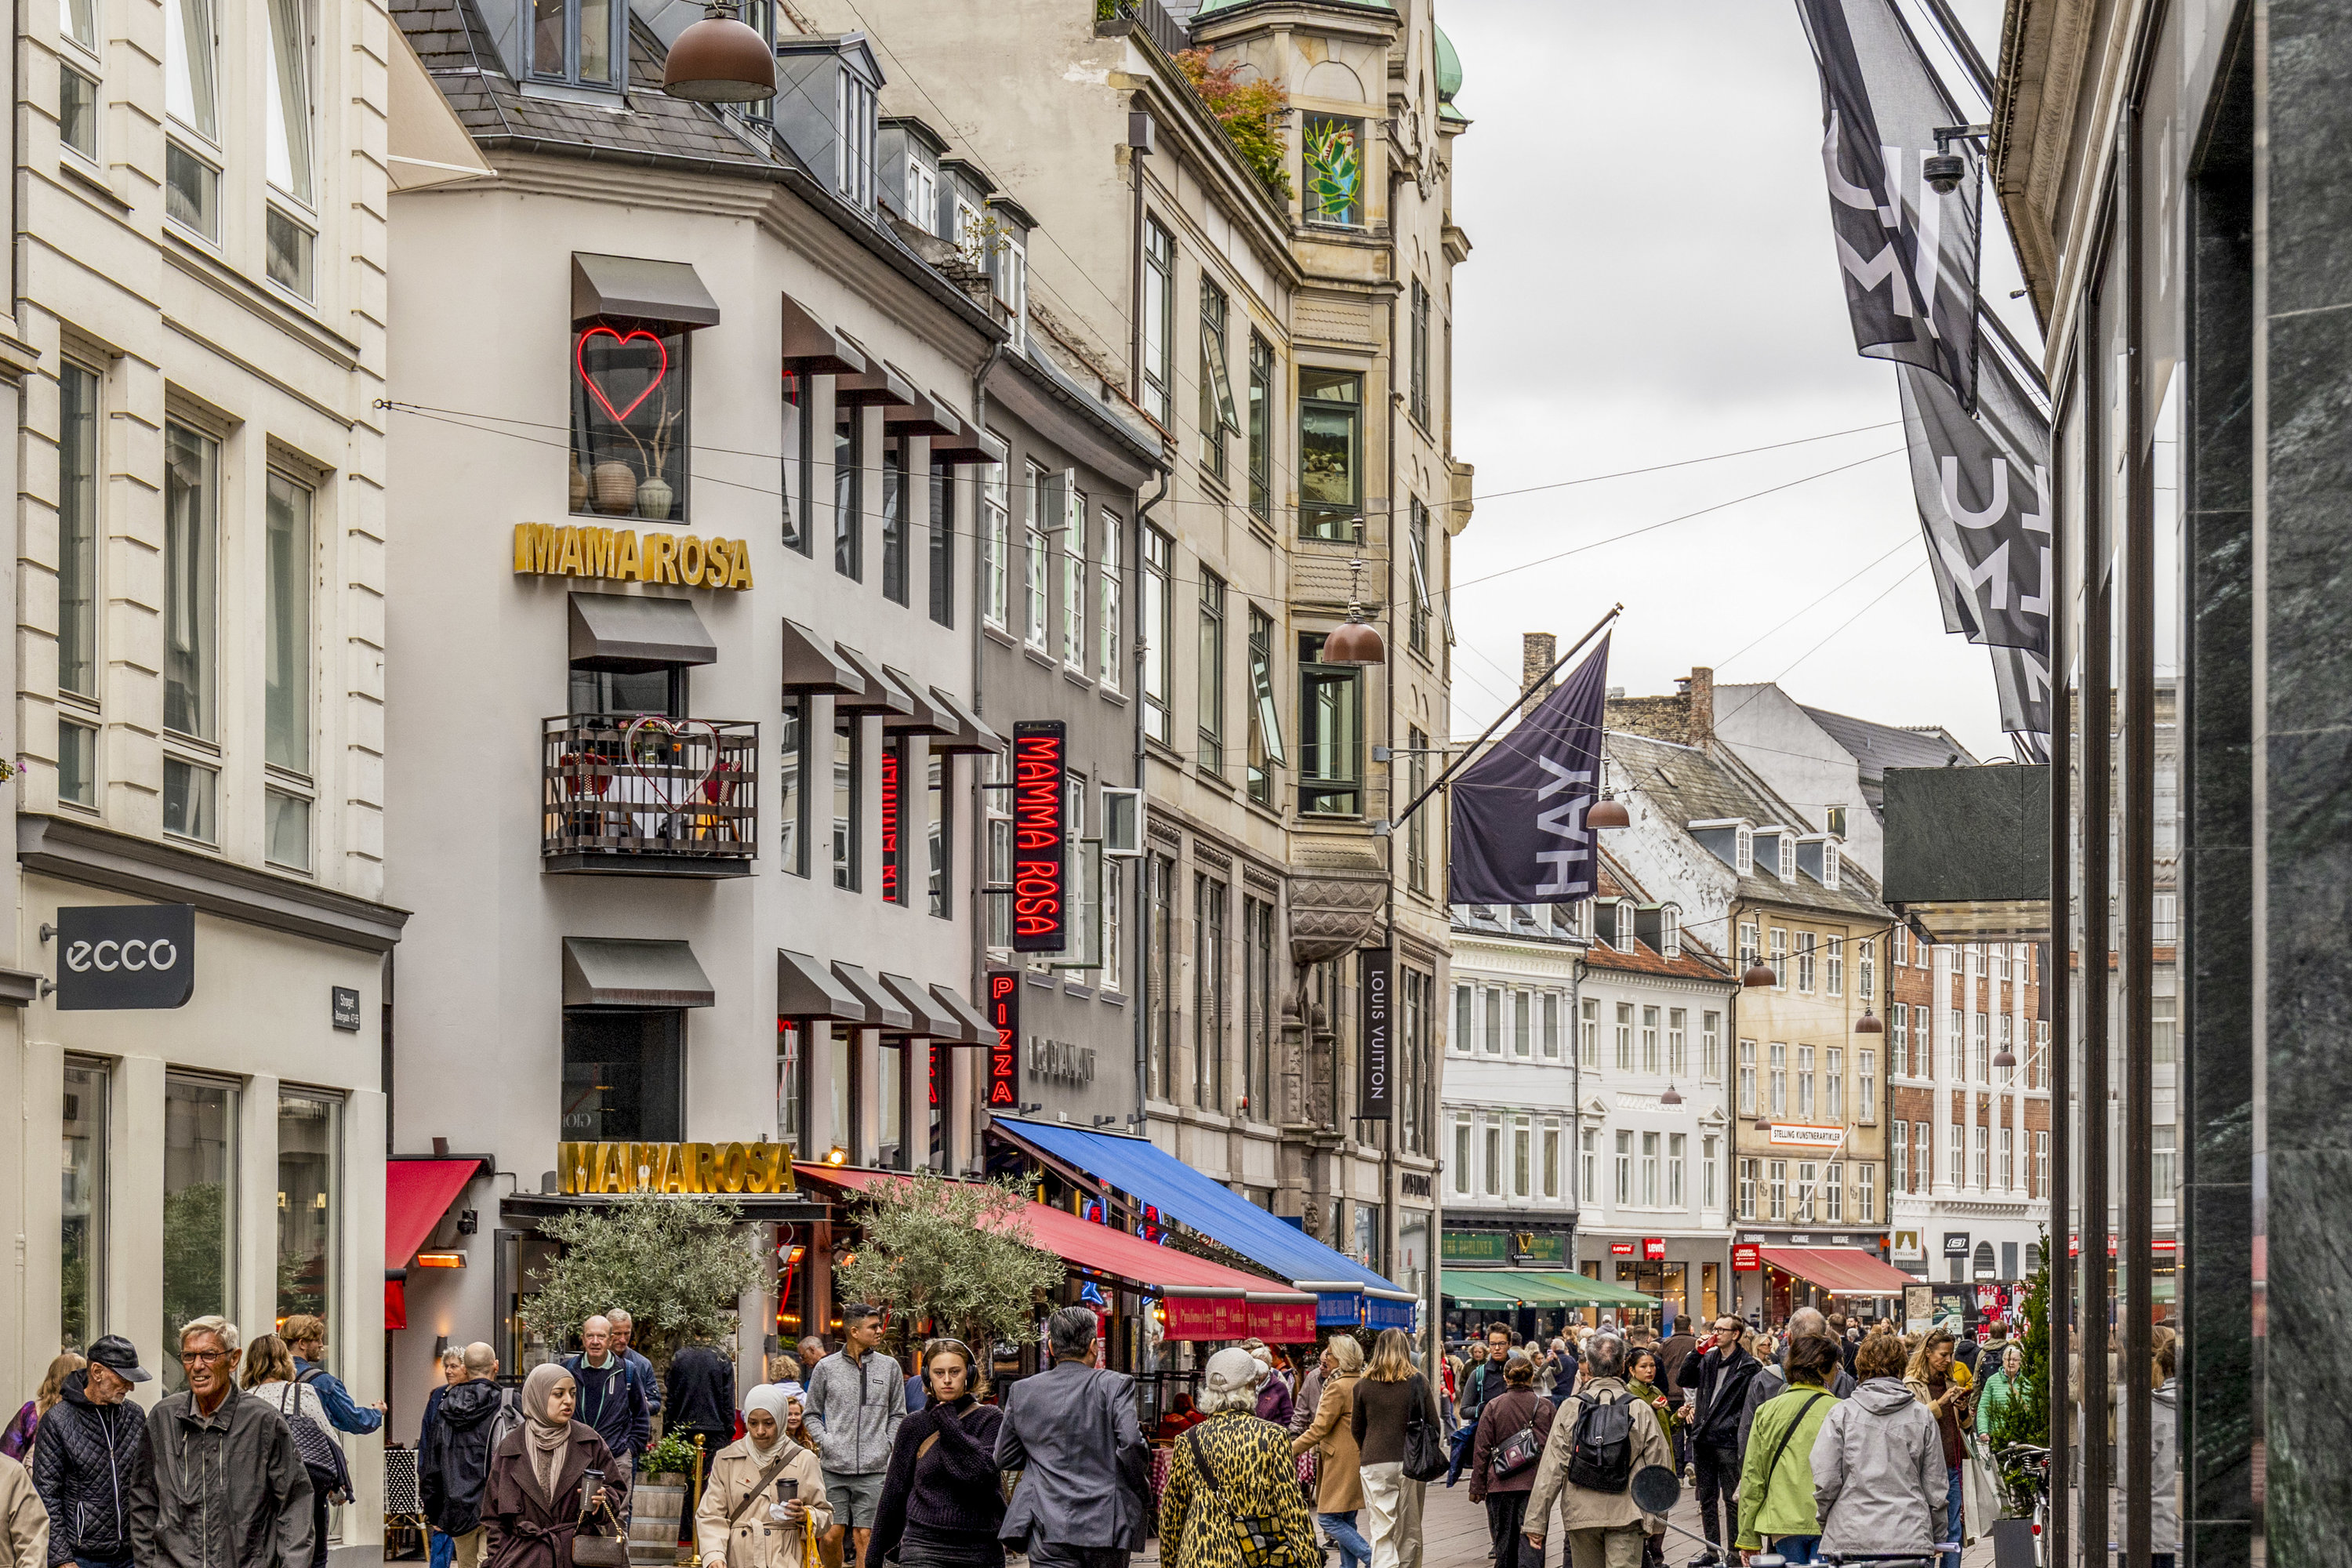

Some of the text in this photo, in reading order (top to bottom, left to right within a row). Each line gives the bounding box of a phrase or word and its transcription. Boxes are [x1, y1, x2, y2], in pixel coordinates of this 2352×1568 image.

[514, 523, 753, 591] MAMA ROSA
[1017, 737, 1060, 935] MAMMA ROSA
[1536, 755, 1592, 895] HAY
[67, 938, 176, 972] ecco
[992, 977, 1014, 1103] PIZZA
[1371, 971, 1385, 1099] LOUIS VUITTON
[1774, 1129, 1841, 1142] STELLING KUNSTNERARTIKLER
[558, 1142, 796, 1193] MAMA ROSA
[1977, 1286, 2002, 1296] PHO
[1982, 1305, 2003, 1316] GRA
[1994, 1294, 2009, 1305] TO
